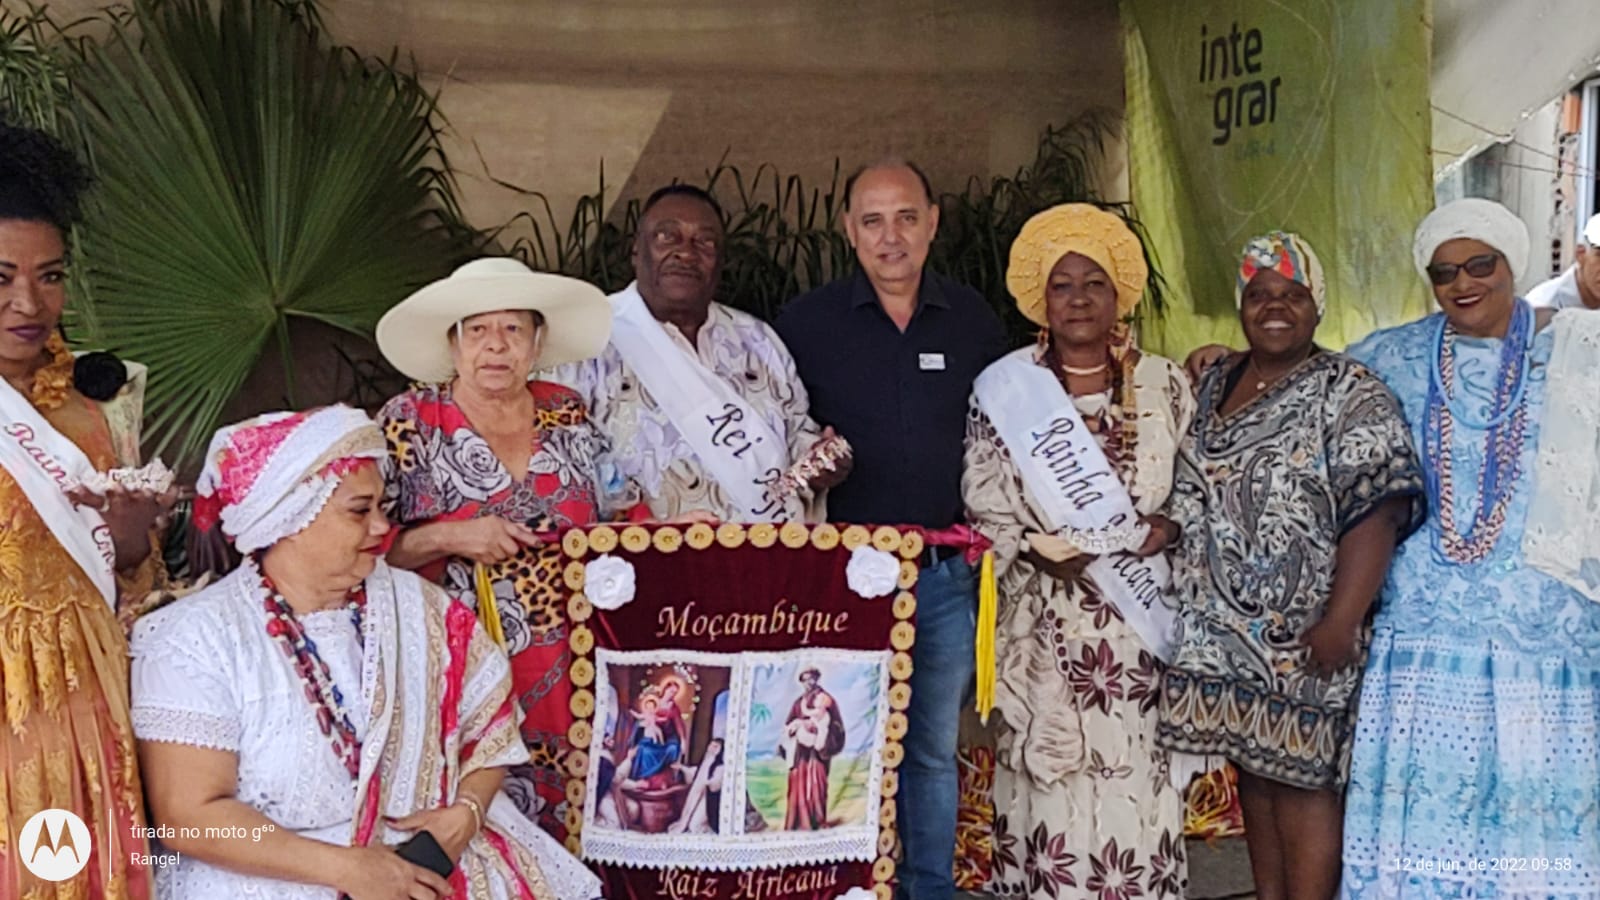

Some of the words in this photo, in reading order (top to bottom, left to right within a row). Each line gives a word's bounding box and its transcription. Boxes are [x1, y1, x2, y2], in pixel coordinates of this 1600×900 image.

[1200, 22, 1263, 83] inte
[1212, 76, 1281, 146] grar
[706, 403, 762, 459] Rei
[1031, 417, 1110, 510] Rainha
[656, 599, 849, 644] Moçambique
[656, 867, 718, 900] Raiz
[731, 865, 838, 900] Africana
